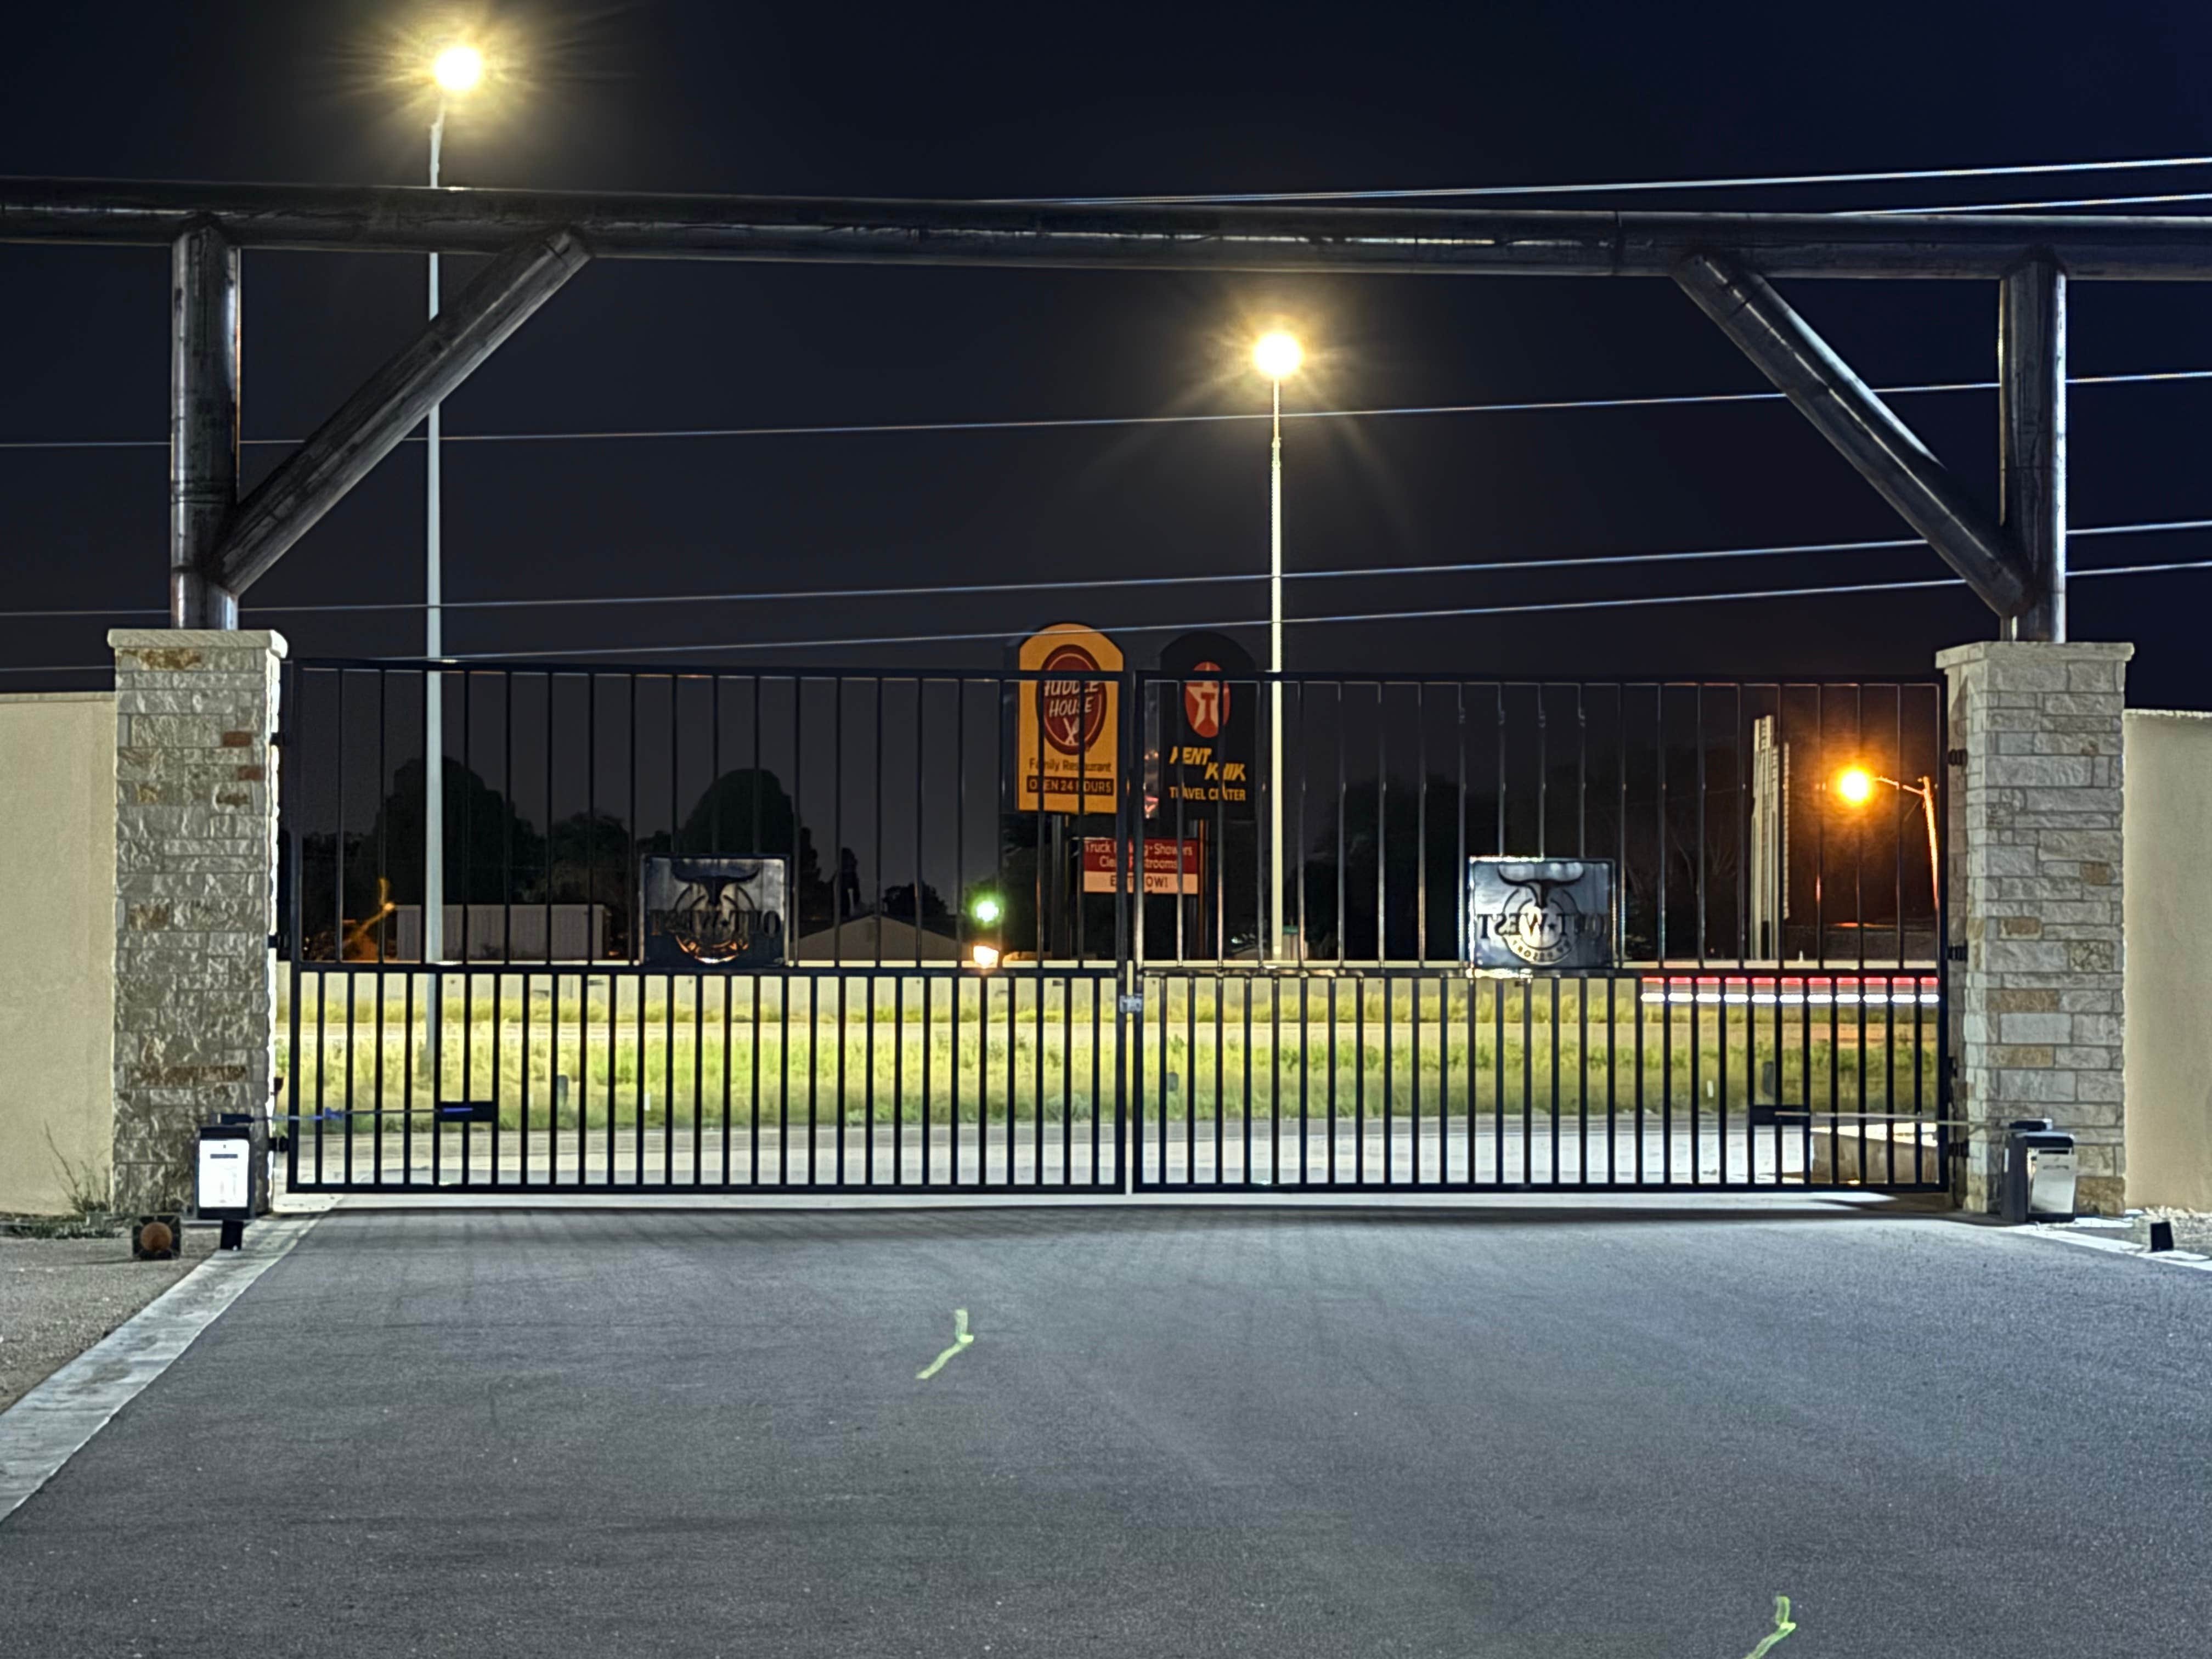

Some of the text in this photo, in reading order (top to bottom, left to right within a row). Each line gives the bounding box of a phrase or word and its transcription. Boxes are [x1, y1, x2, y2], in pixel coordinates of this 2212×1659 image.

[1049, 696, 1094, 717] HOUE
[1029, 779, 1059, 791] OEN
[1060, 780, 1074, 791] 24
[1084, 841, 1111, 852] Truck
[1154, 843, 1193, 855] Showrs
